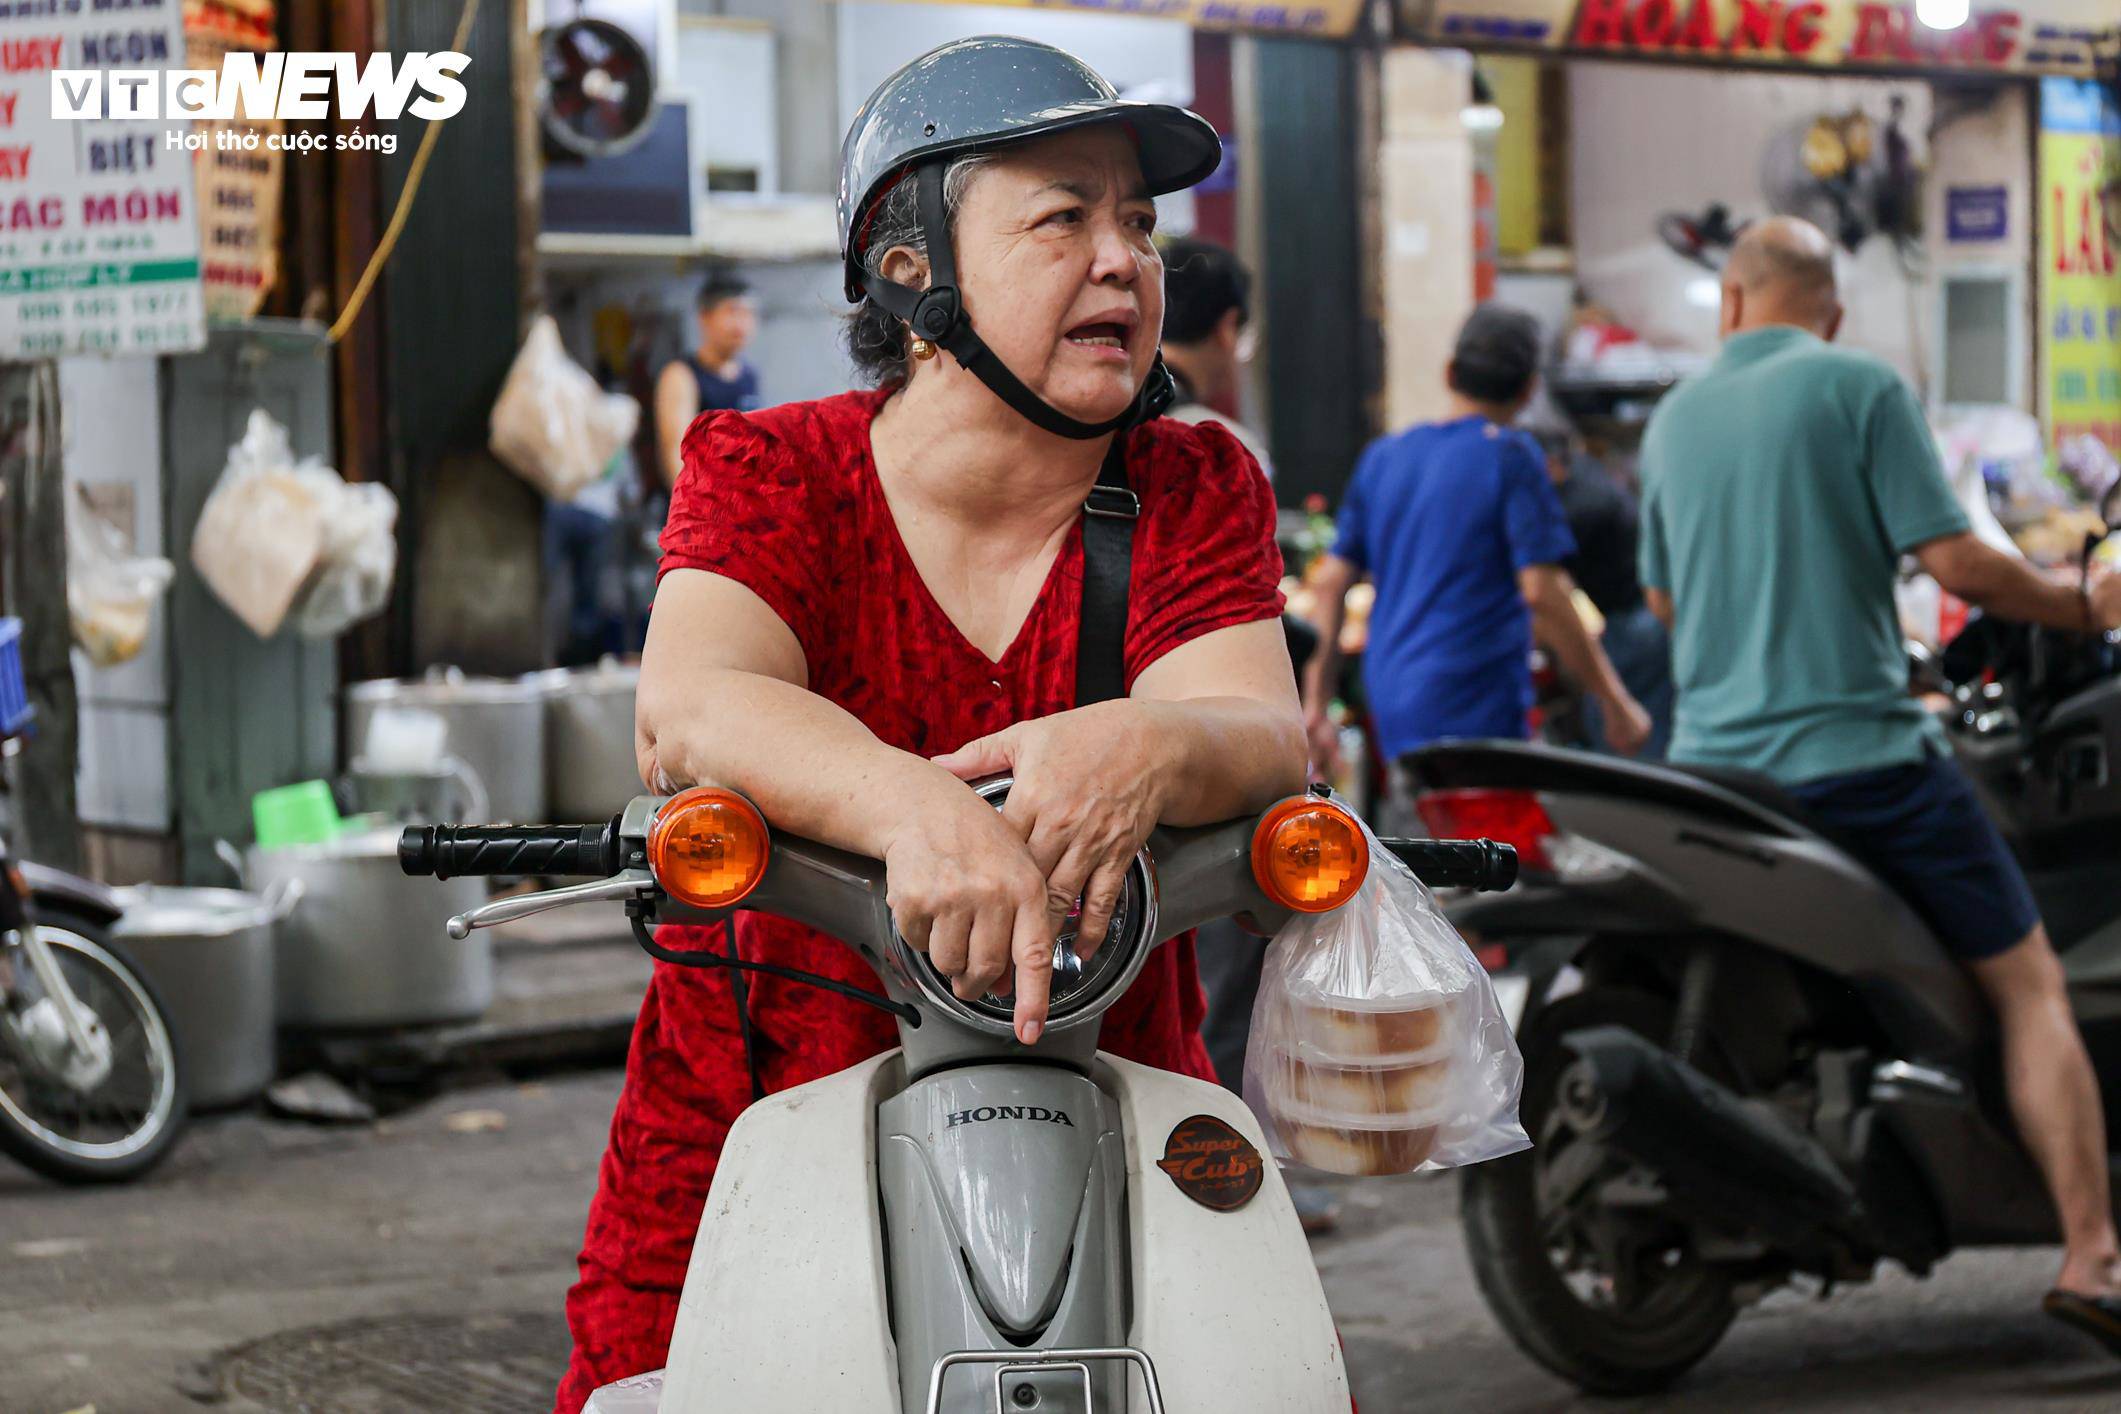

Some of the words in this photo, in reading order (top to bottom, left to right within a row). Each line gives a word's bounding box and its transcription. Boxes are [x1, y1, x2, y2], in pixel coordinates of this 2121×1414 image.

[946, 1106, 1075, 1128] HONDA
[1169, 1131, 1243, 1155] Super
[1182, 1155, 1248, 1180] Cub
